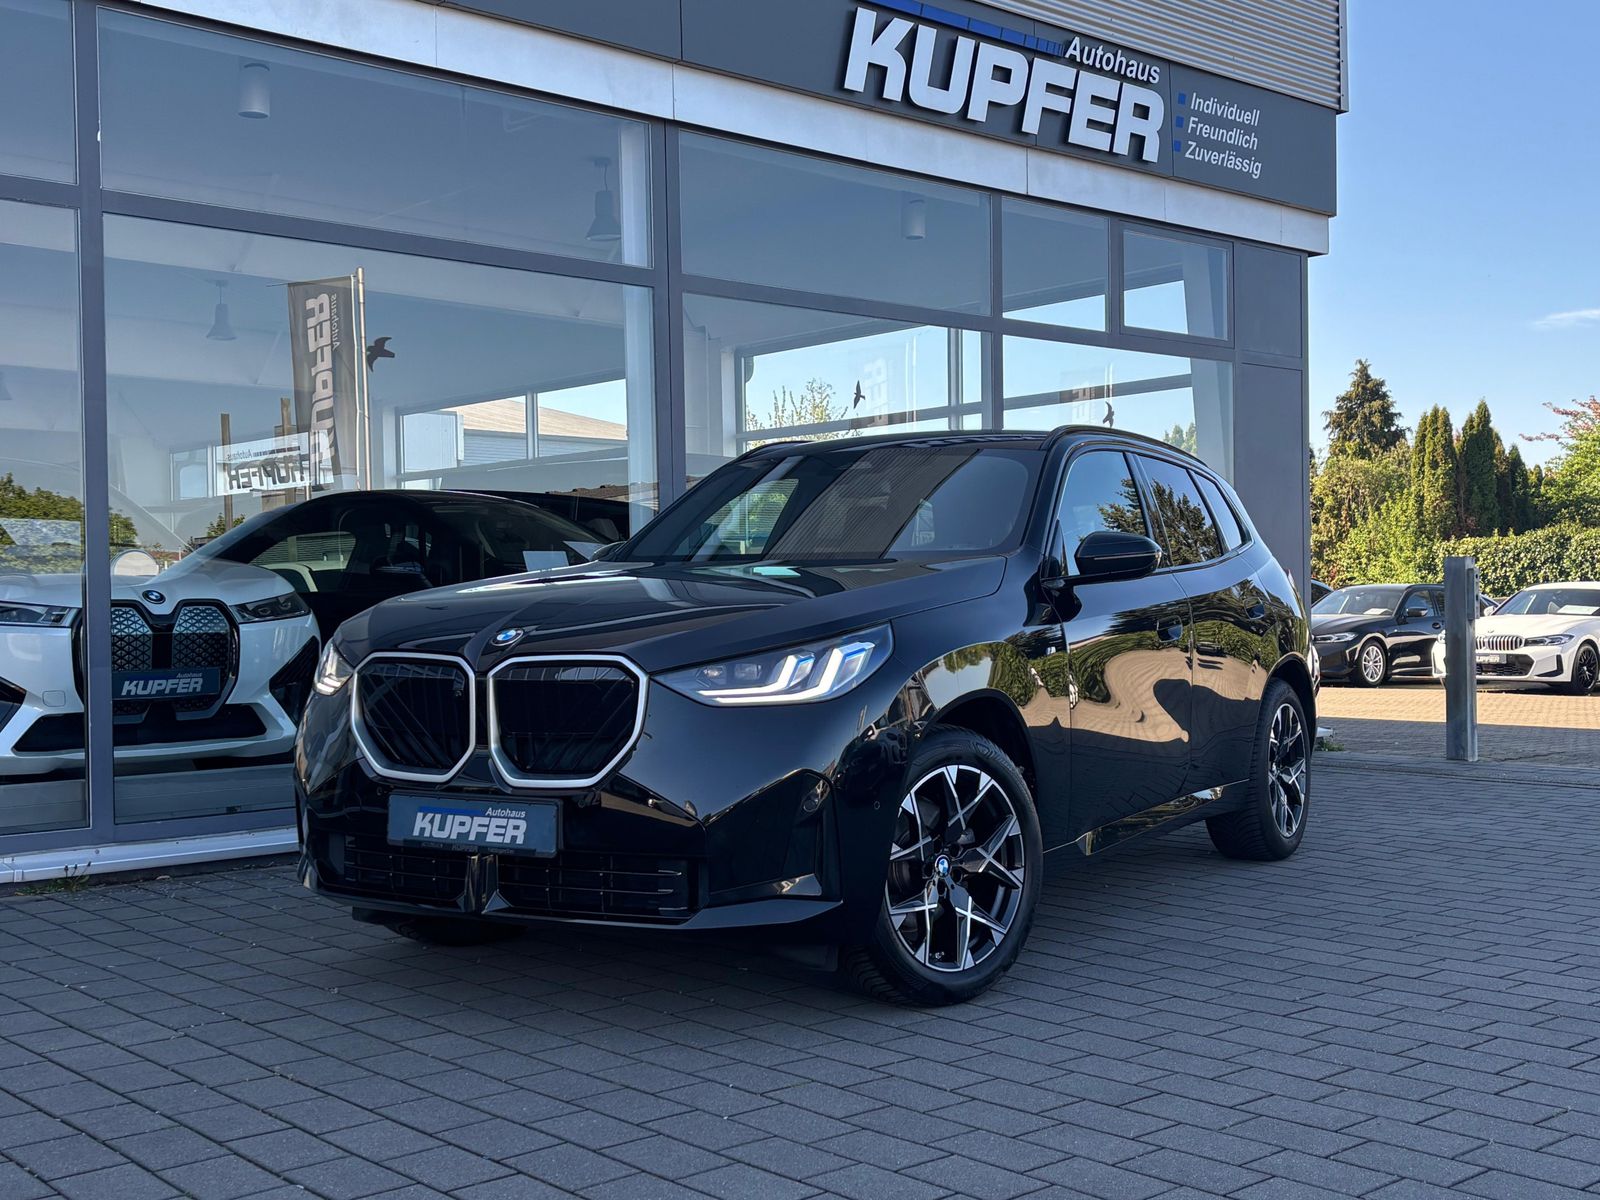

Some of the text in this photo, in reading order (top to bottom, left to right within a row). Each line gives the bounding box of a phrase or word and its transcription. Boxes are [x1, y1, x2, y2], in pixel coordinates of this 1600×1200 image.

[1064, 36, 1161, 84] Autohaus
[844, 6, 1165, 163] KUPFER
[1190, 92, 1261, 126] Individuell
[1187, 117, 1259, 151] Freundlich
[1185, 140, 1262, 179] Zuverlässig
[1476, 655, 1500, 664] UPFER
[121, 678, 203, 696] KUPFER
[412, 812, 528, 845] KUPFER
[485, 807, 526, 818] Autohaus
